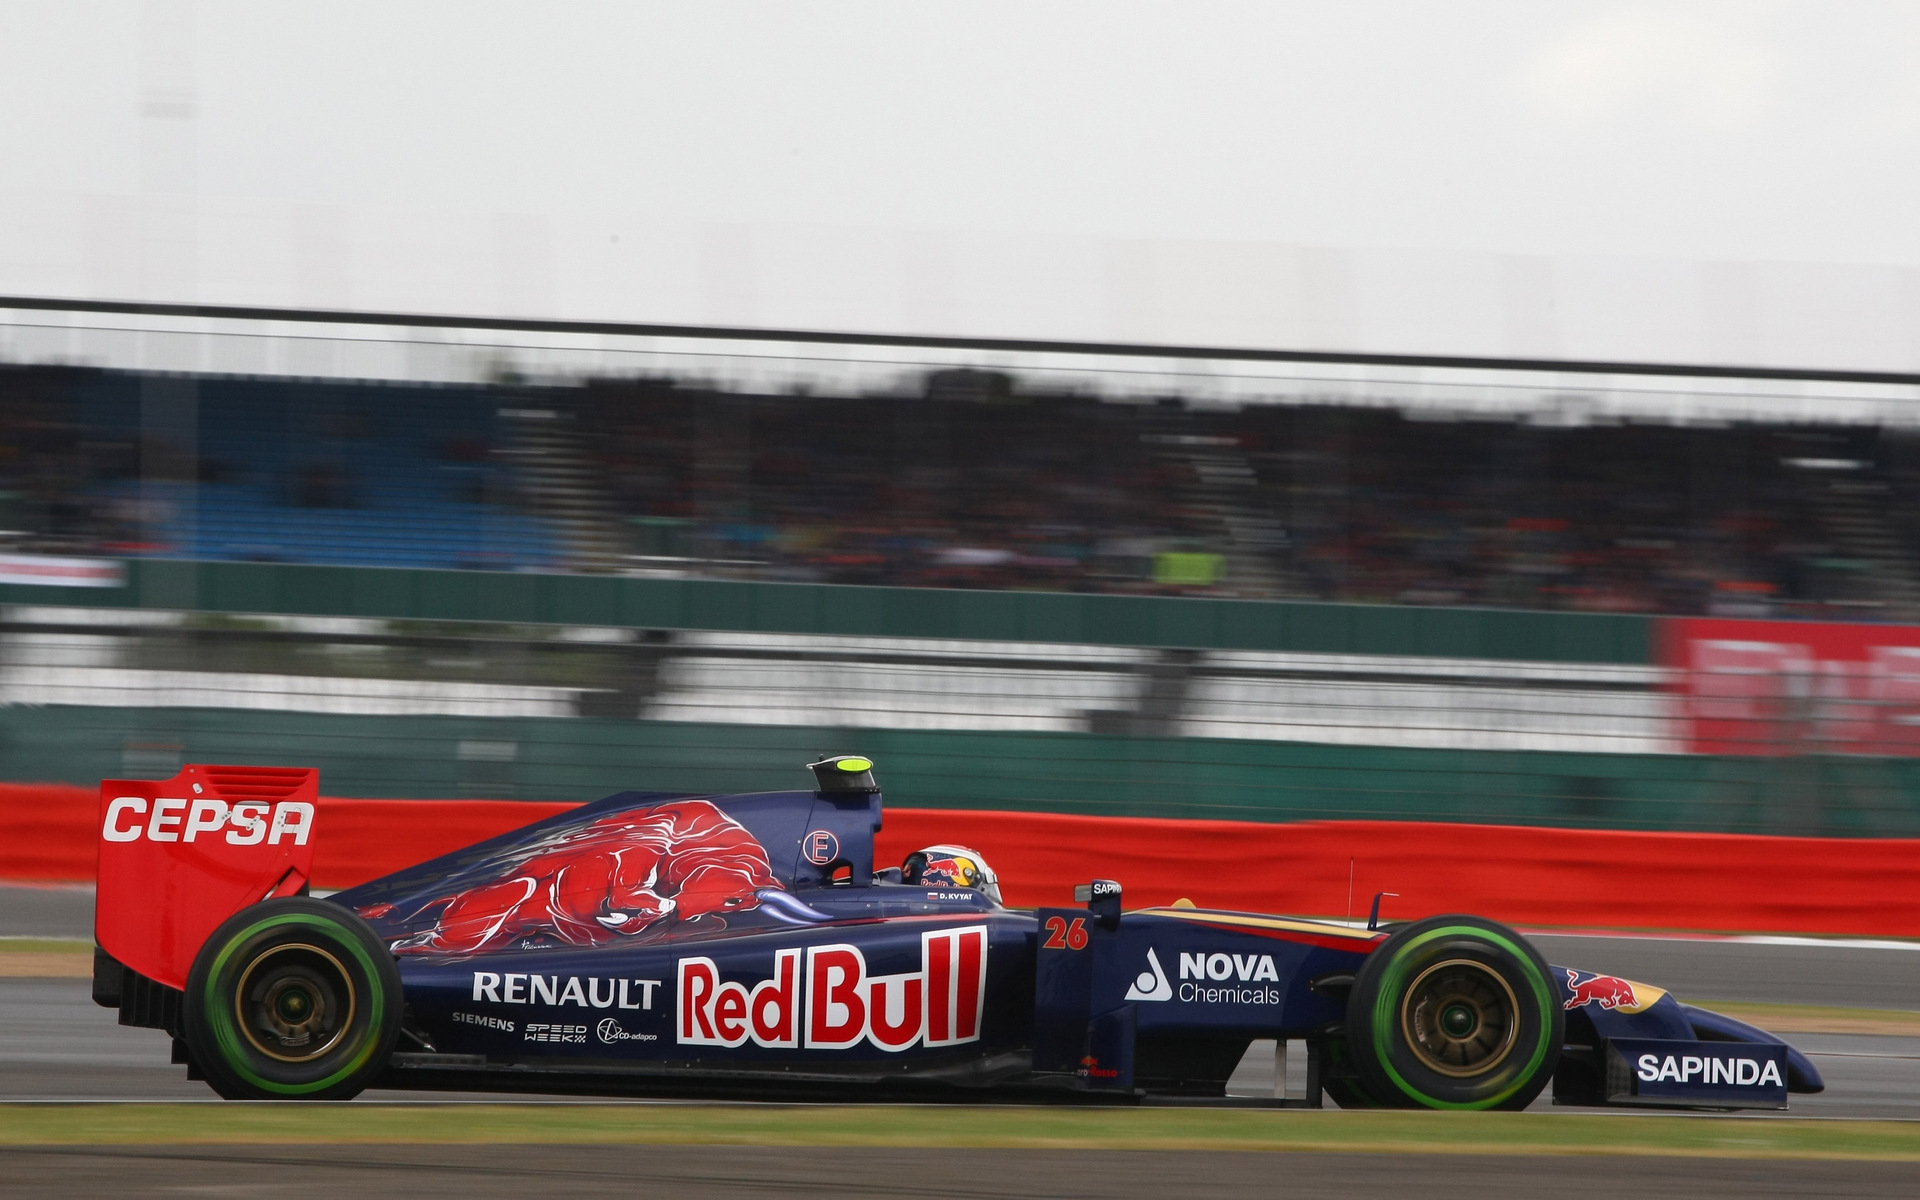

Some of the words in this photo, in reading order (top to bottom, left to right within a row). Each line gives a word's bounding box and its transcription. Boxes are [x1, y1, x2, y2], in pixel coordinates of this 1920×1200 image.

[102, 796, 315, 846] CEPSA
[812, 833, 829, 862] E
[1042, 915, 1089, 950] 26
[1179, 952, 1280, 982] NOVA
[472, 971, 662, 1011] RENAULT
[677, 949, 802, 1048] Red
[803, 925, 988, 1053] Bull
[1179, 982, 1280, 1005] Chemicals
[452, 1012, 515, 1033] SIEMENS
[525, 1023, 587, 1034] SPEED
[524, 1033, 574, 1043] WEEK
[619, 1032, 658, 1043] CD-adapco
[1637, 1053, 1783, 1087] SAPINDA
